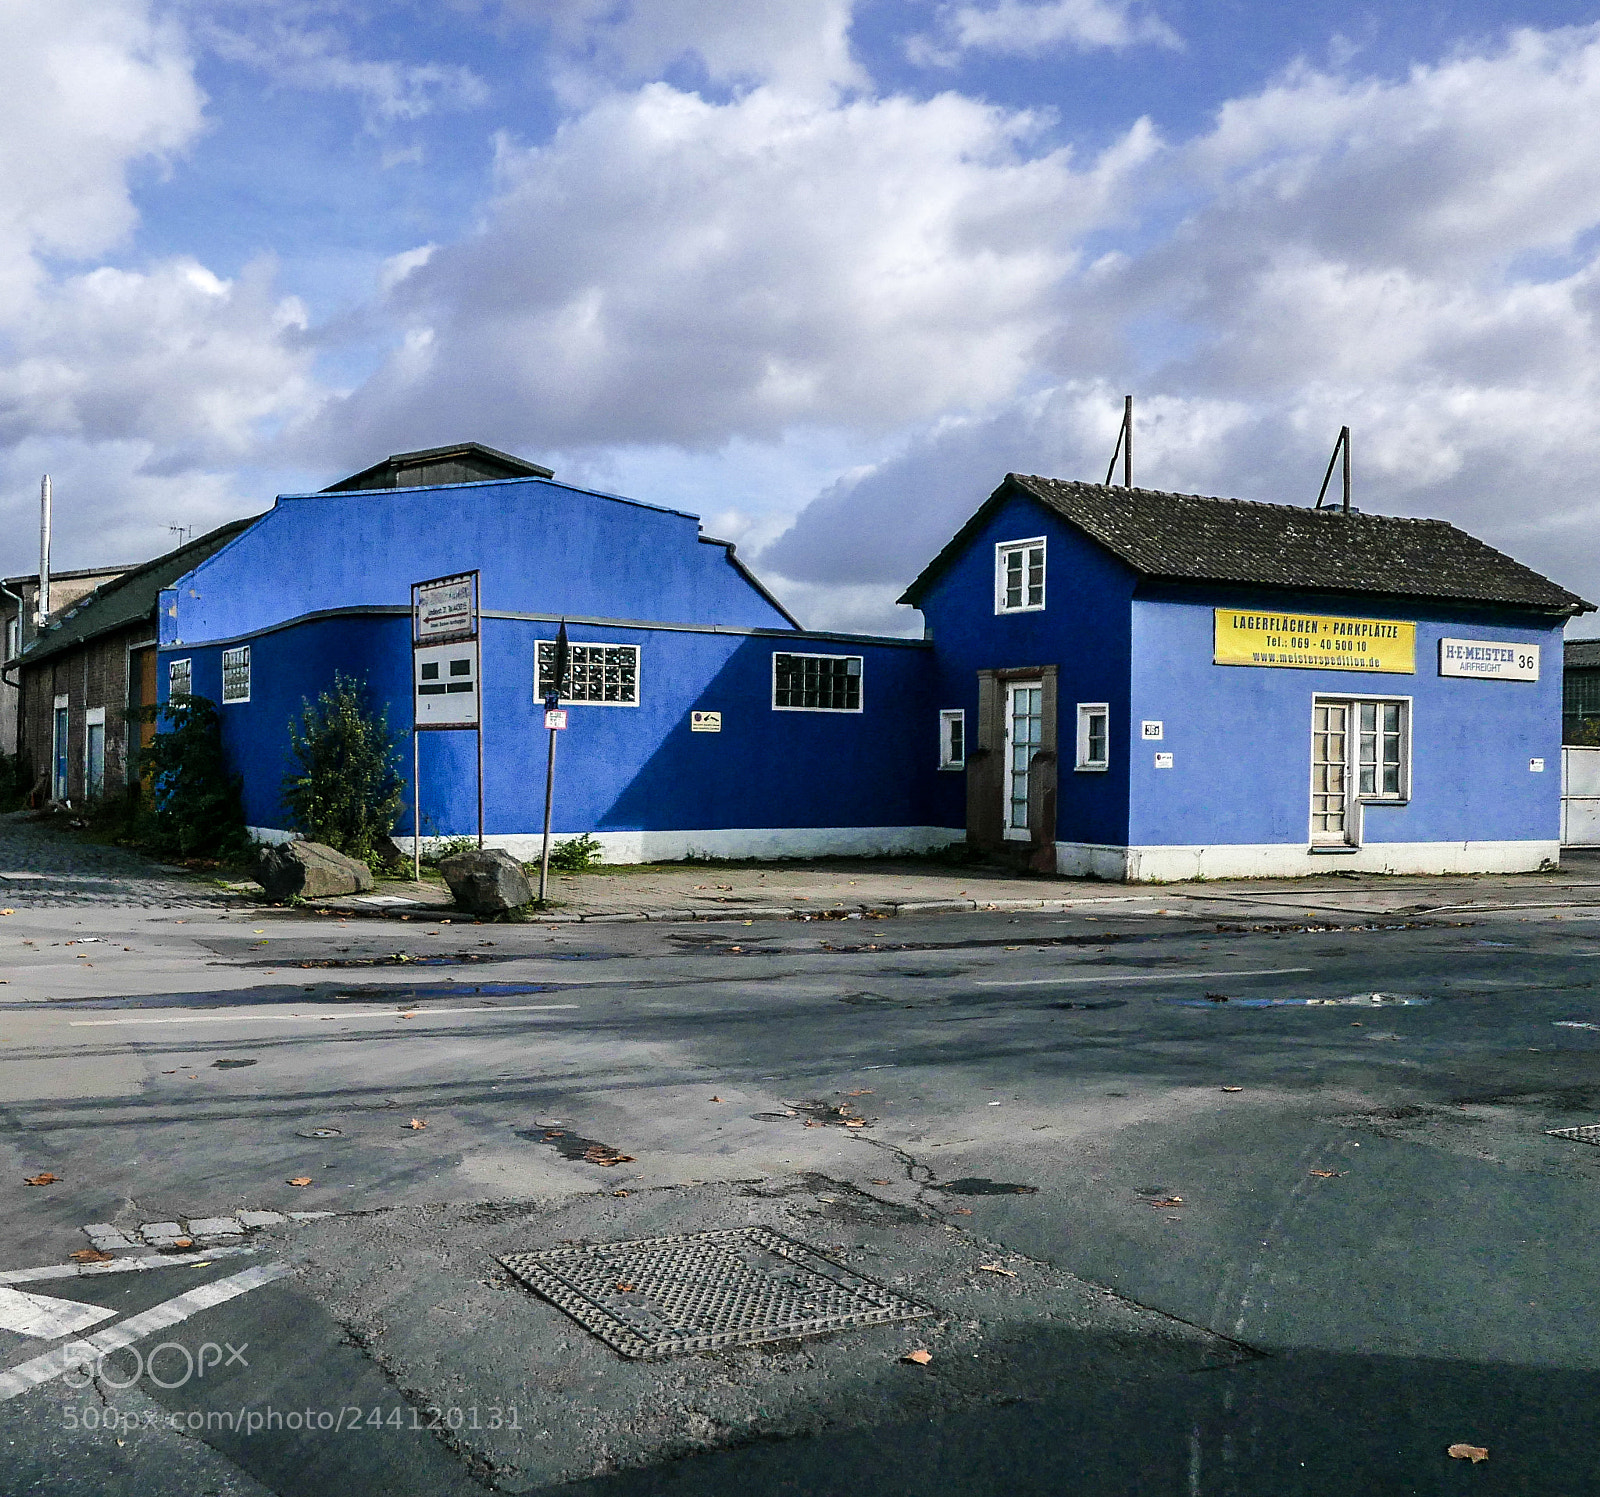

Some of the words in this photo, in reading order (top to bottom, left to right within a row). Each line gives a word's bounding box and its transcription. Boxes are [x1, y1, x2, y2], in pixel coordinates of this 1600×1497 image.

[1233, 615, 1318, 634] LAGERFLÄCHEN
[1322, 624, 1329, 632] +
[1333, 622, 1398, 639] PARKPLÄTZE
[1266, 635, 1288, 648] Tel.:
[1291, 637, 1310, 649] 069
[1320, 638, 1332, 650] 40
[1335, 639, 1353, 652] 500
[1356, 640, 1367, 652] 10
[1252, 652, 1380, 668] www.meisterspedition.de
[1460, 661, 1502, 673] AIRFREIGHT
[1518, 654, 1534, 669] 36
